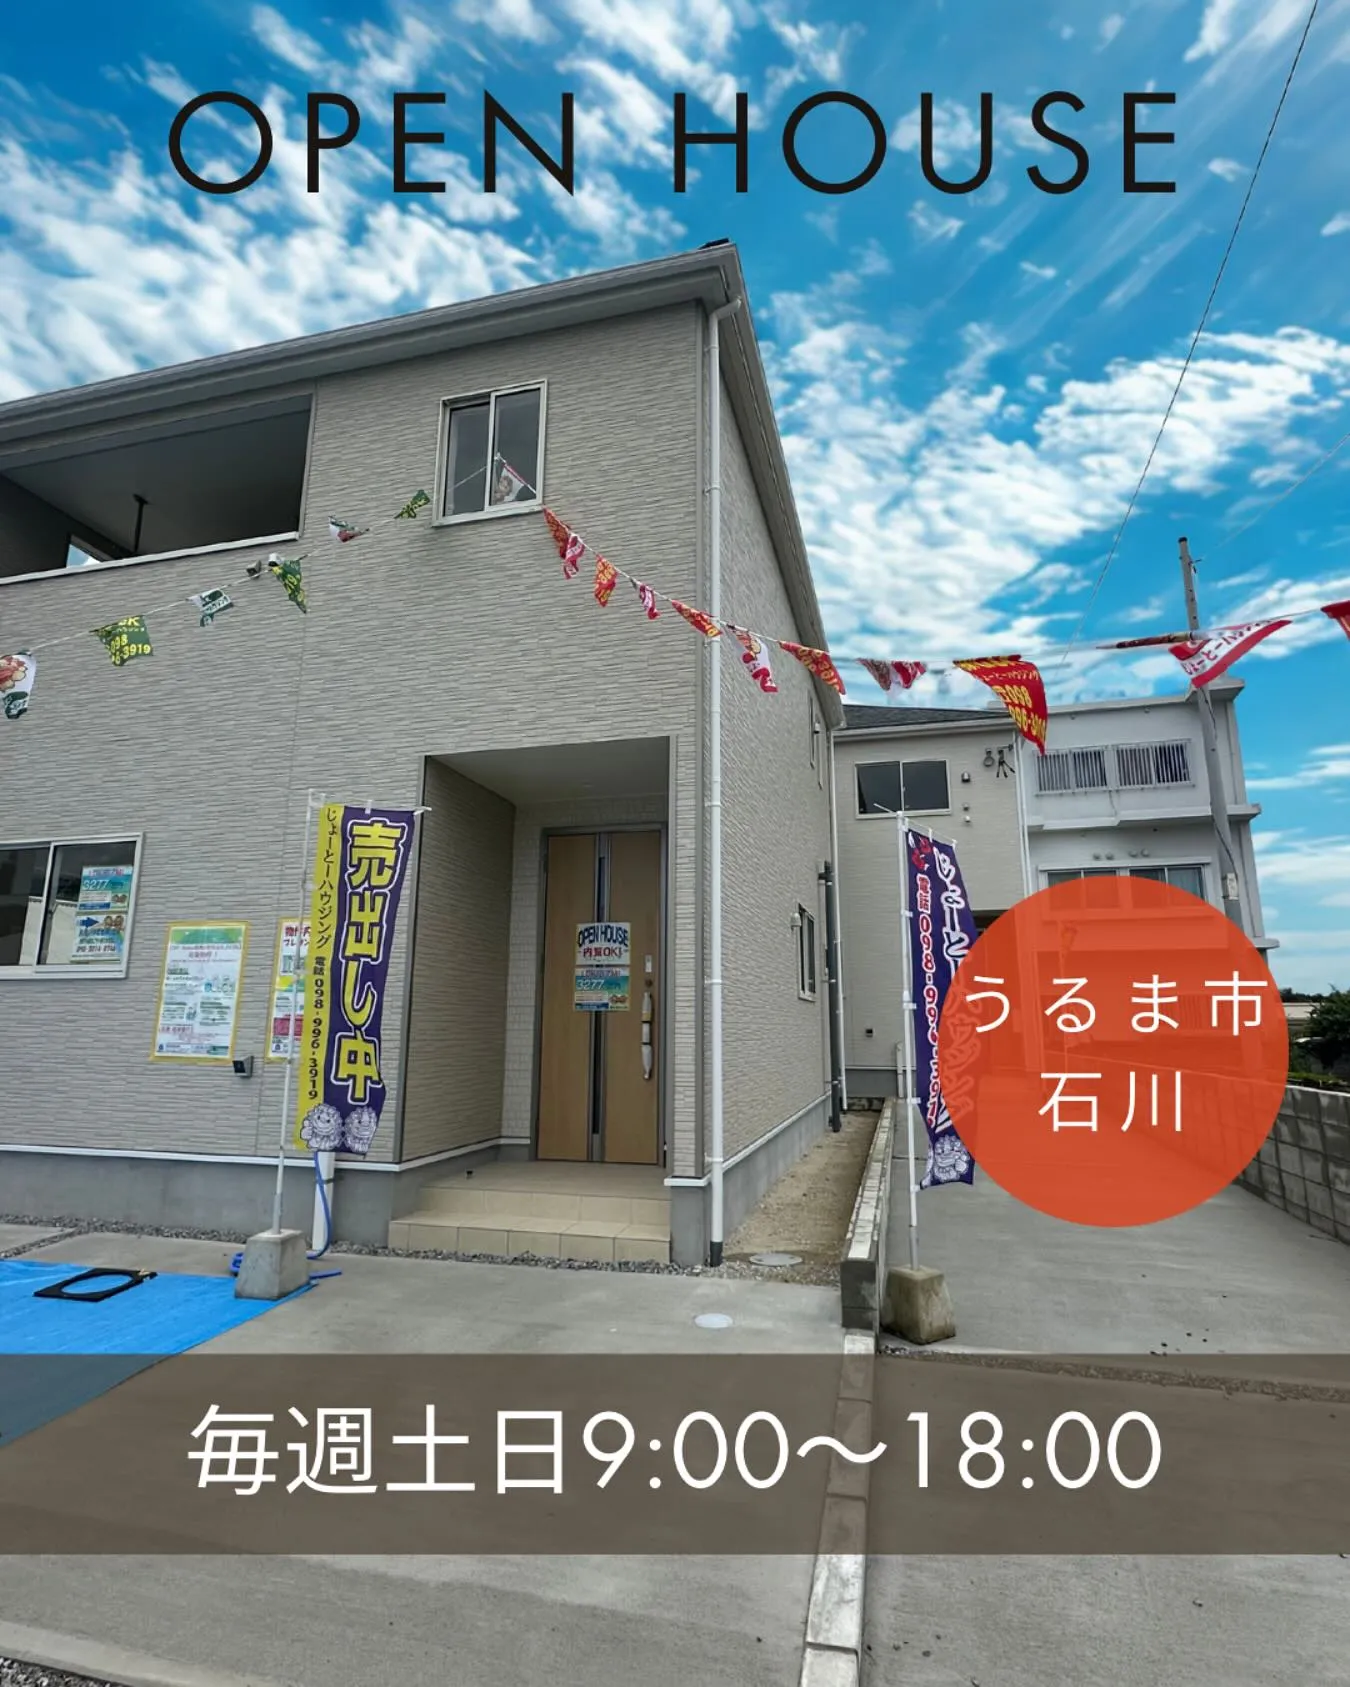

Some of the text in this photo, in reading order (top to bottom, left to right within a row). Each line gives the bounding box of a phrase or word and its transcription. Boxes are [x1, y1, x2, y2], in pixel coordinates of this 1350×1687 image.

[315, 807, 338, 949] じょーとーハウジング
[577, 925, 628, 947] OPEN HOUSE
[335, 820, 405, 1102] 売出し中
